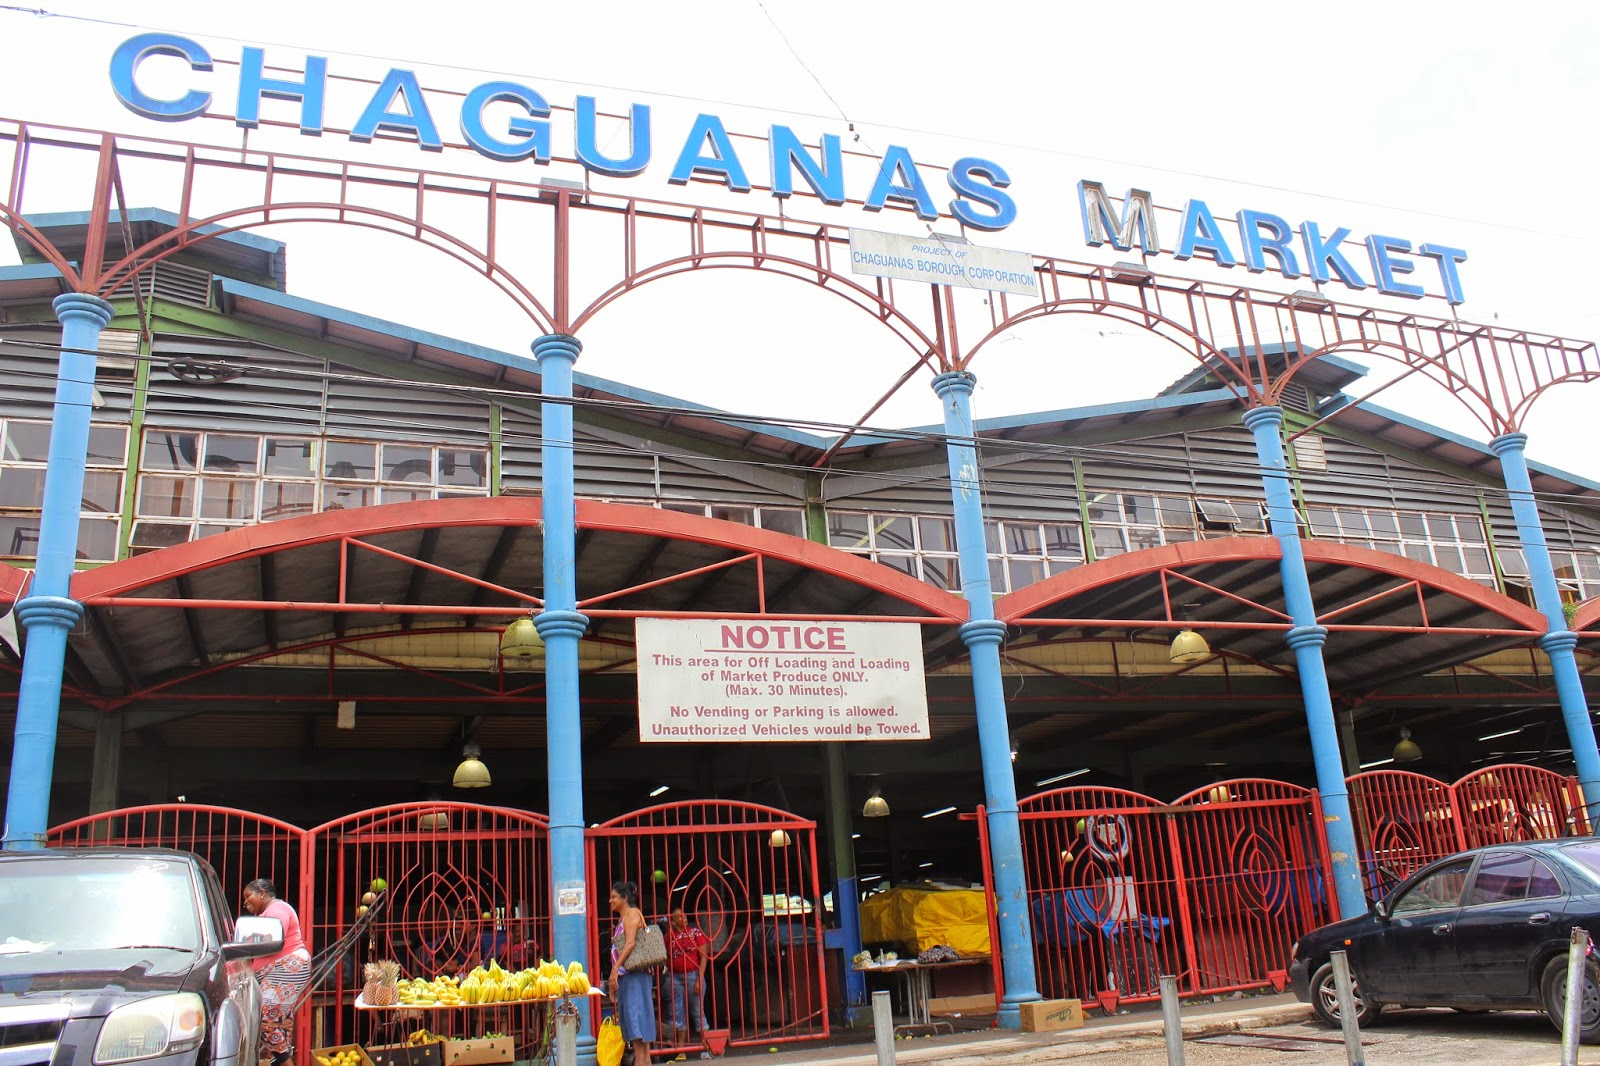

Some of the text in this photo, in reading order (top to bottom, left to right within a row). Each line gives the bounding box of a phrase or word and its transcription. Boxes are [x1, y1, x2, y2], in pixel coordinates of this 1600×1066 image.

[109, 31, 1468, 306] CHAGUANAS MARKET
[911, 245, 953, 256] PROJECT
[853, 252, 1034, 286] CHAGUANAS BOROUGH CORPORATION
[721, 625, 846, 650] NOTICE
[652, 654, 910, 671] This area for Off Loading and Loading
[701, 671, 868, 683] of Market Produce ONLY.
[725, 685, 848, 698] (Max. 30 Minutes).
[670, 706, 898, 719] No Vending or Parking is allowed.
[652, 723, 921, 736] Unauthorized Vehicles would be Towed.
